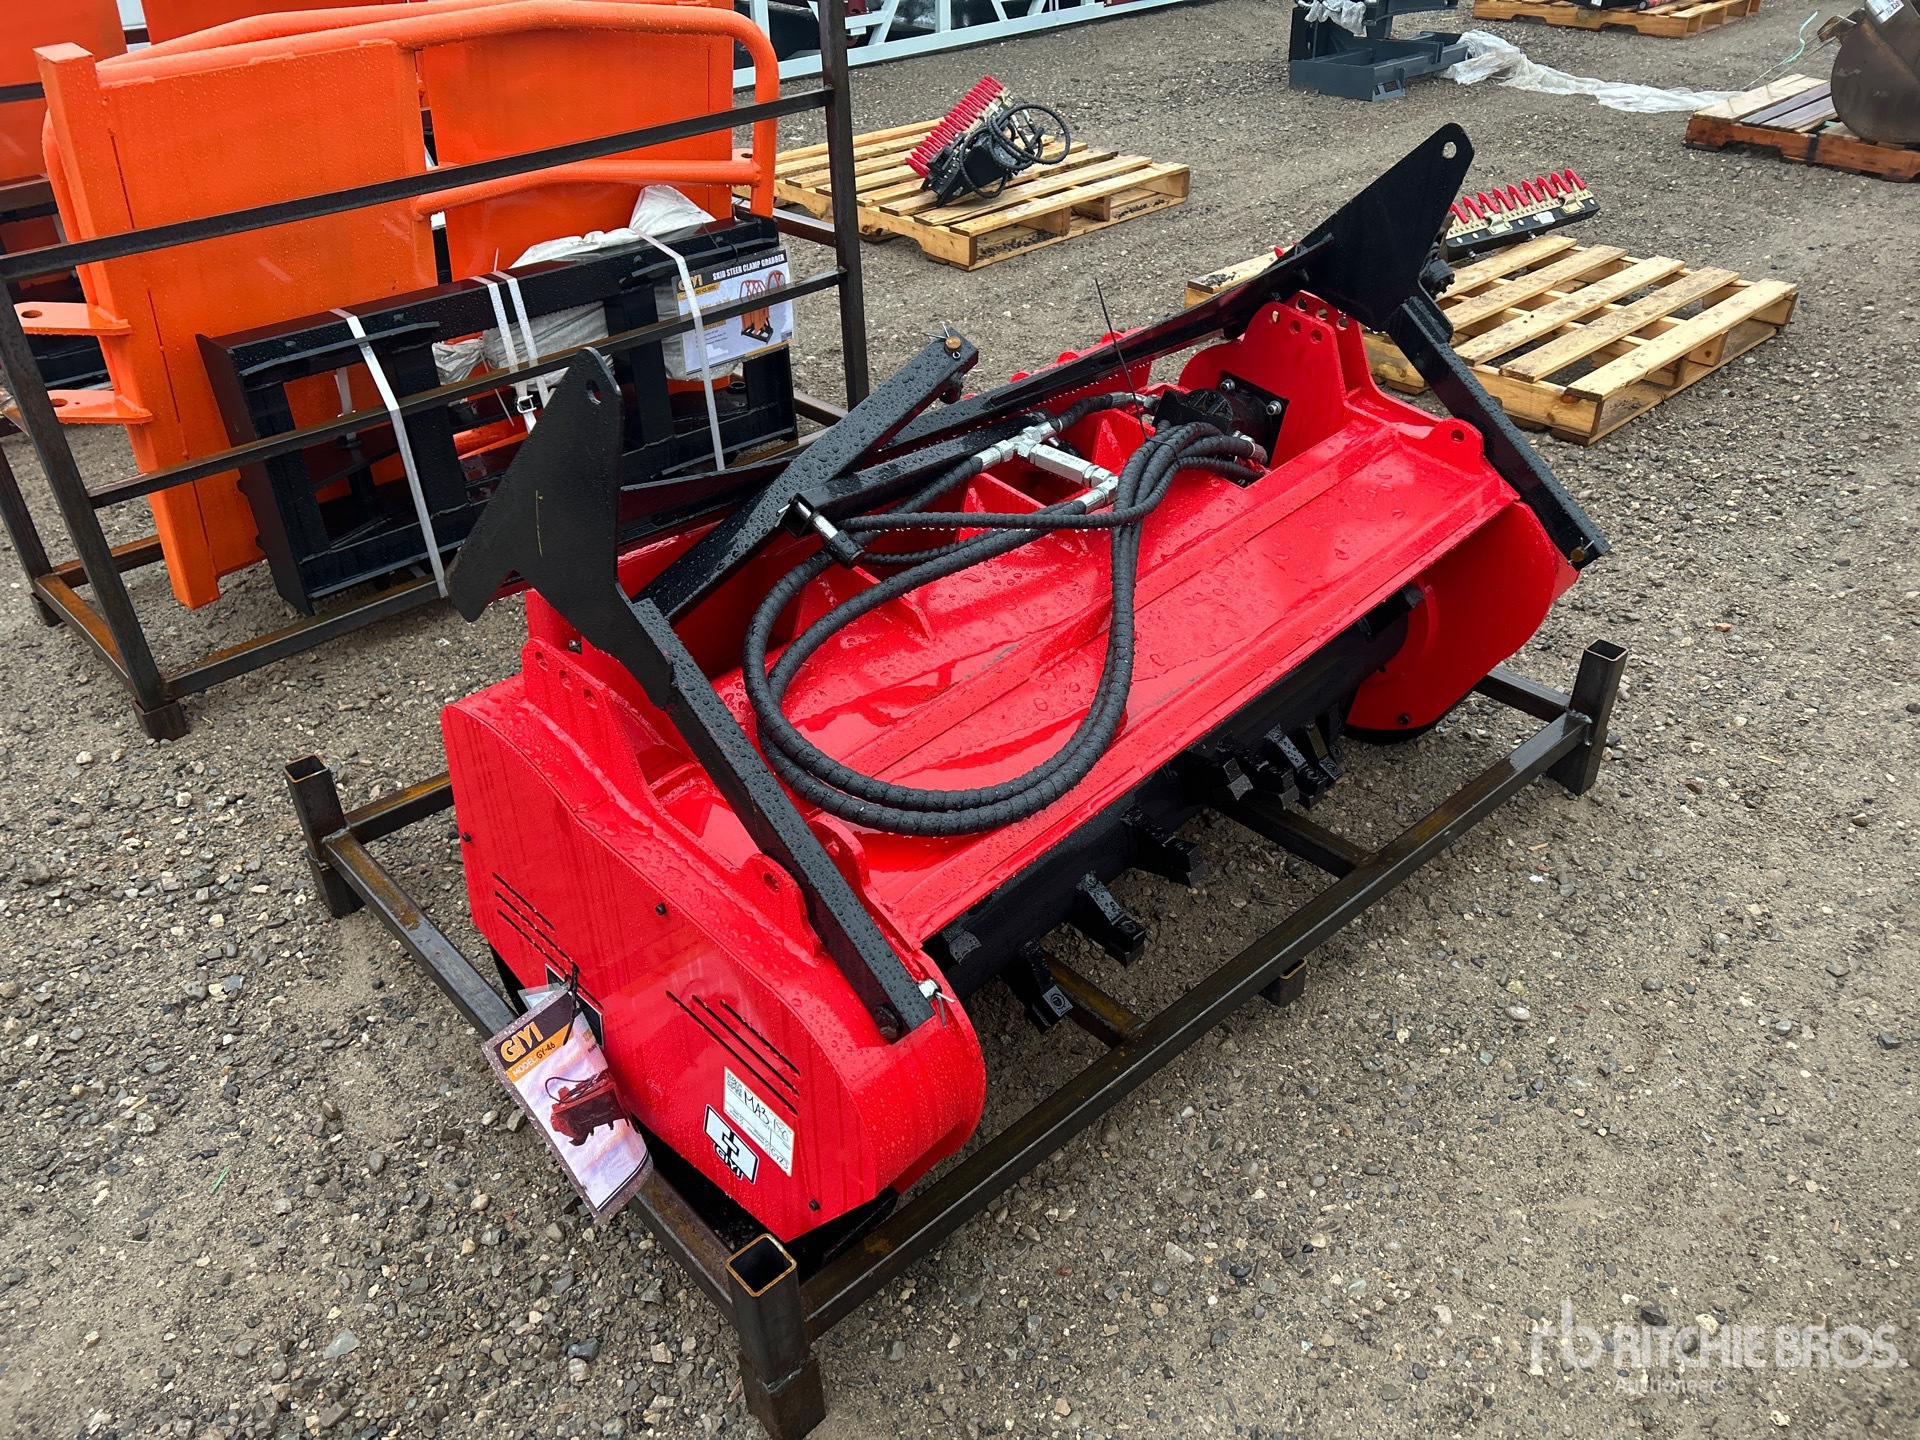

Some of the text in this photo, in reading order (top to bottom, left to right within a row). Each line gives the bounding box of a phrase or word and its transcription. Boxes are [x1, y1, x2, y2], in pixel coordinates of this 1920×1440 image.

[712, 253, 785, 281] SKID STEER CLAMP GRABBER
[501, 1021, 544, 1063] GIYI
[536, 1041, 556, 1059] GY-46
[715, 1146, 742, 1178] GIYI
